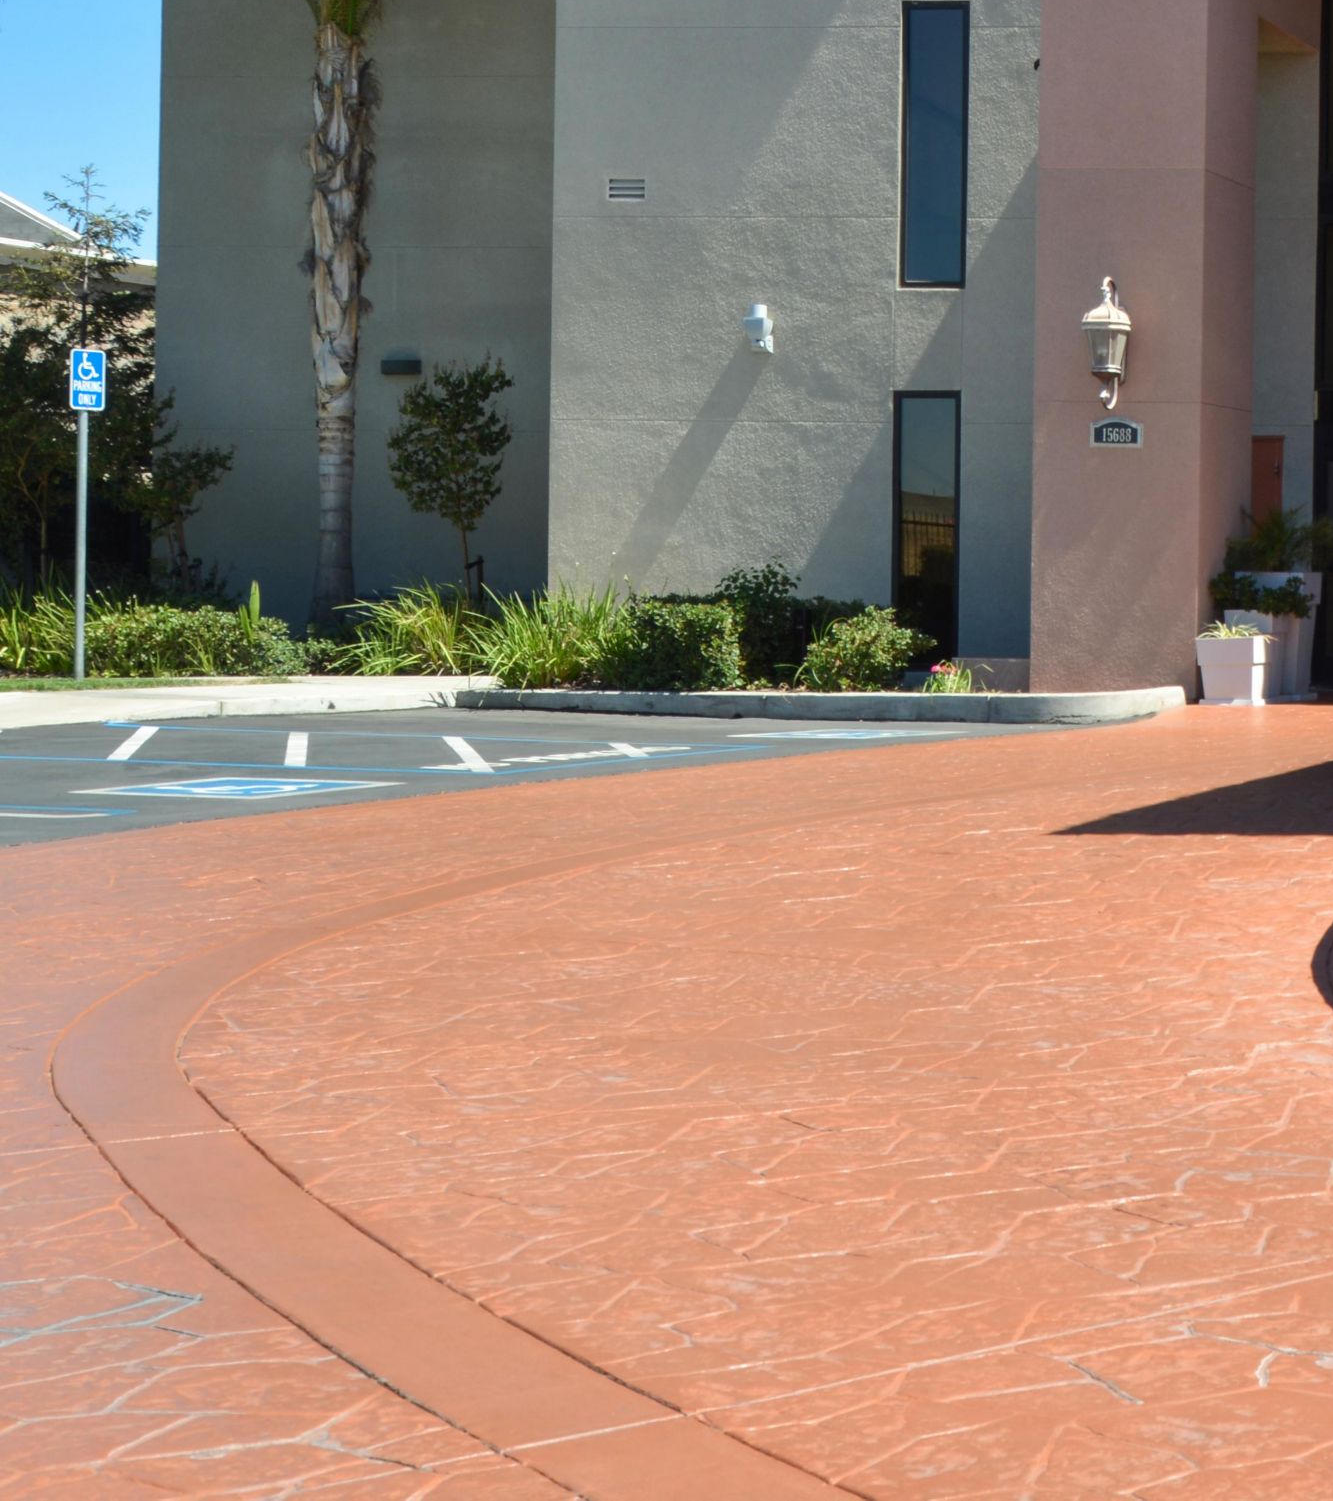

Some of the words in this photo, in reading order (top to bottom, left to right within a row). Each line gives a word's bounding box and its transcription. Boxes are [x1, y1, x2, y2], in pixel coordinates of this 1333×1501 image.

[73, 380, 102, 392] PARKING
[78, 393, 97, 405] ONLY
[1102, 427, 1132, 442] 15688
